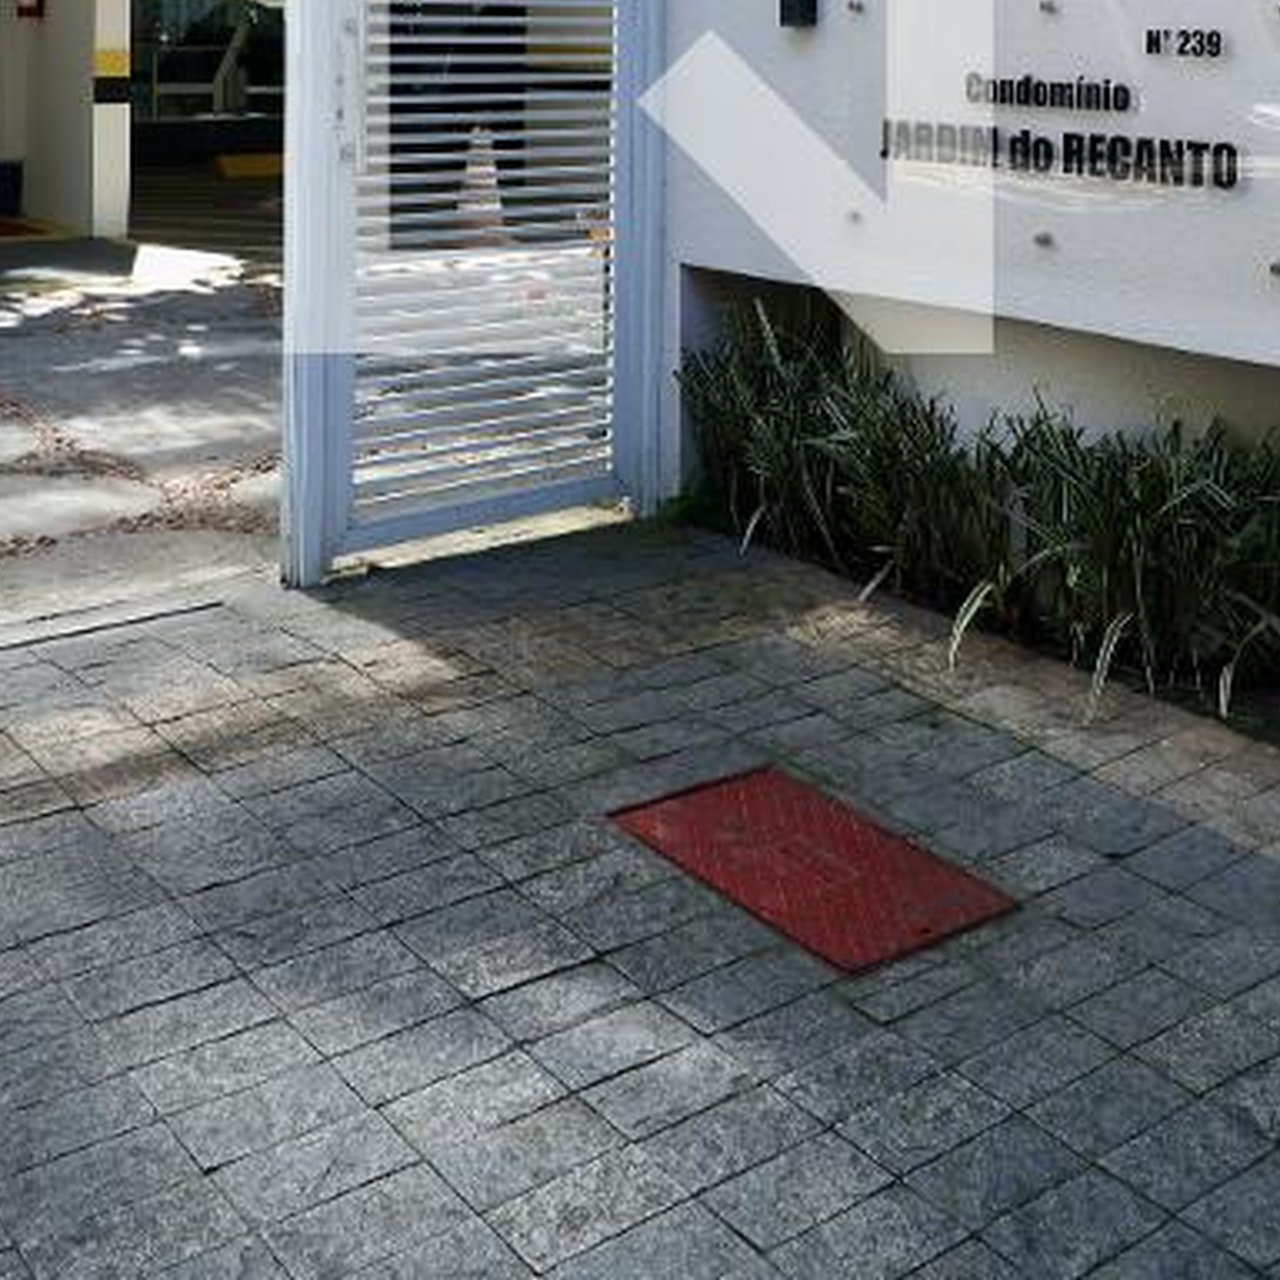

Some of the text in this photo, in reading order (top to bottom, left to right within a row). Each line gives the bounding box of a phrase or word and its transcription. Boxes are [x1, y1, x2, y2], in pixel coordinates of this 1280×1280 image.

[1177, 29, 1221, 57] 239
[965, 72, 1131, 112] Condomínio
[880, 118, 1237, 189] JARDIM do RECANTO
